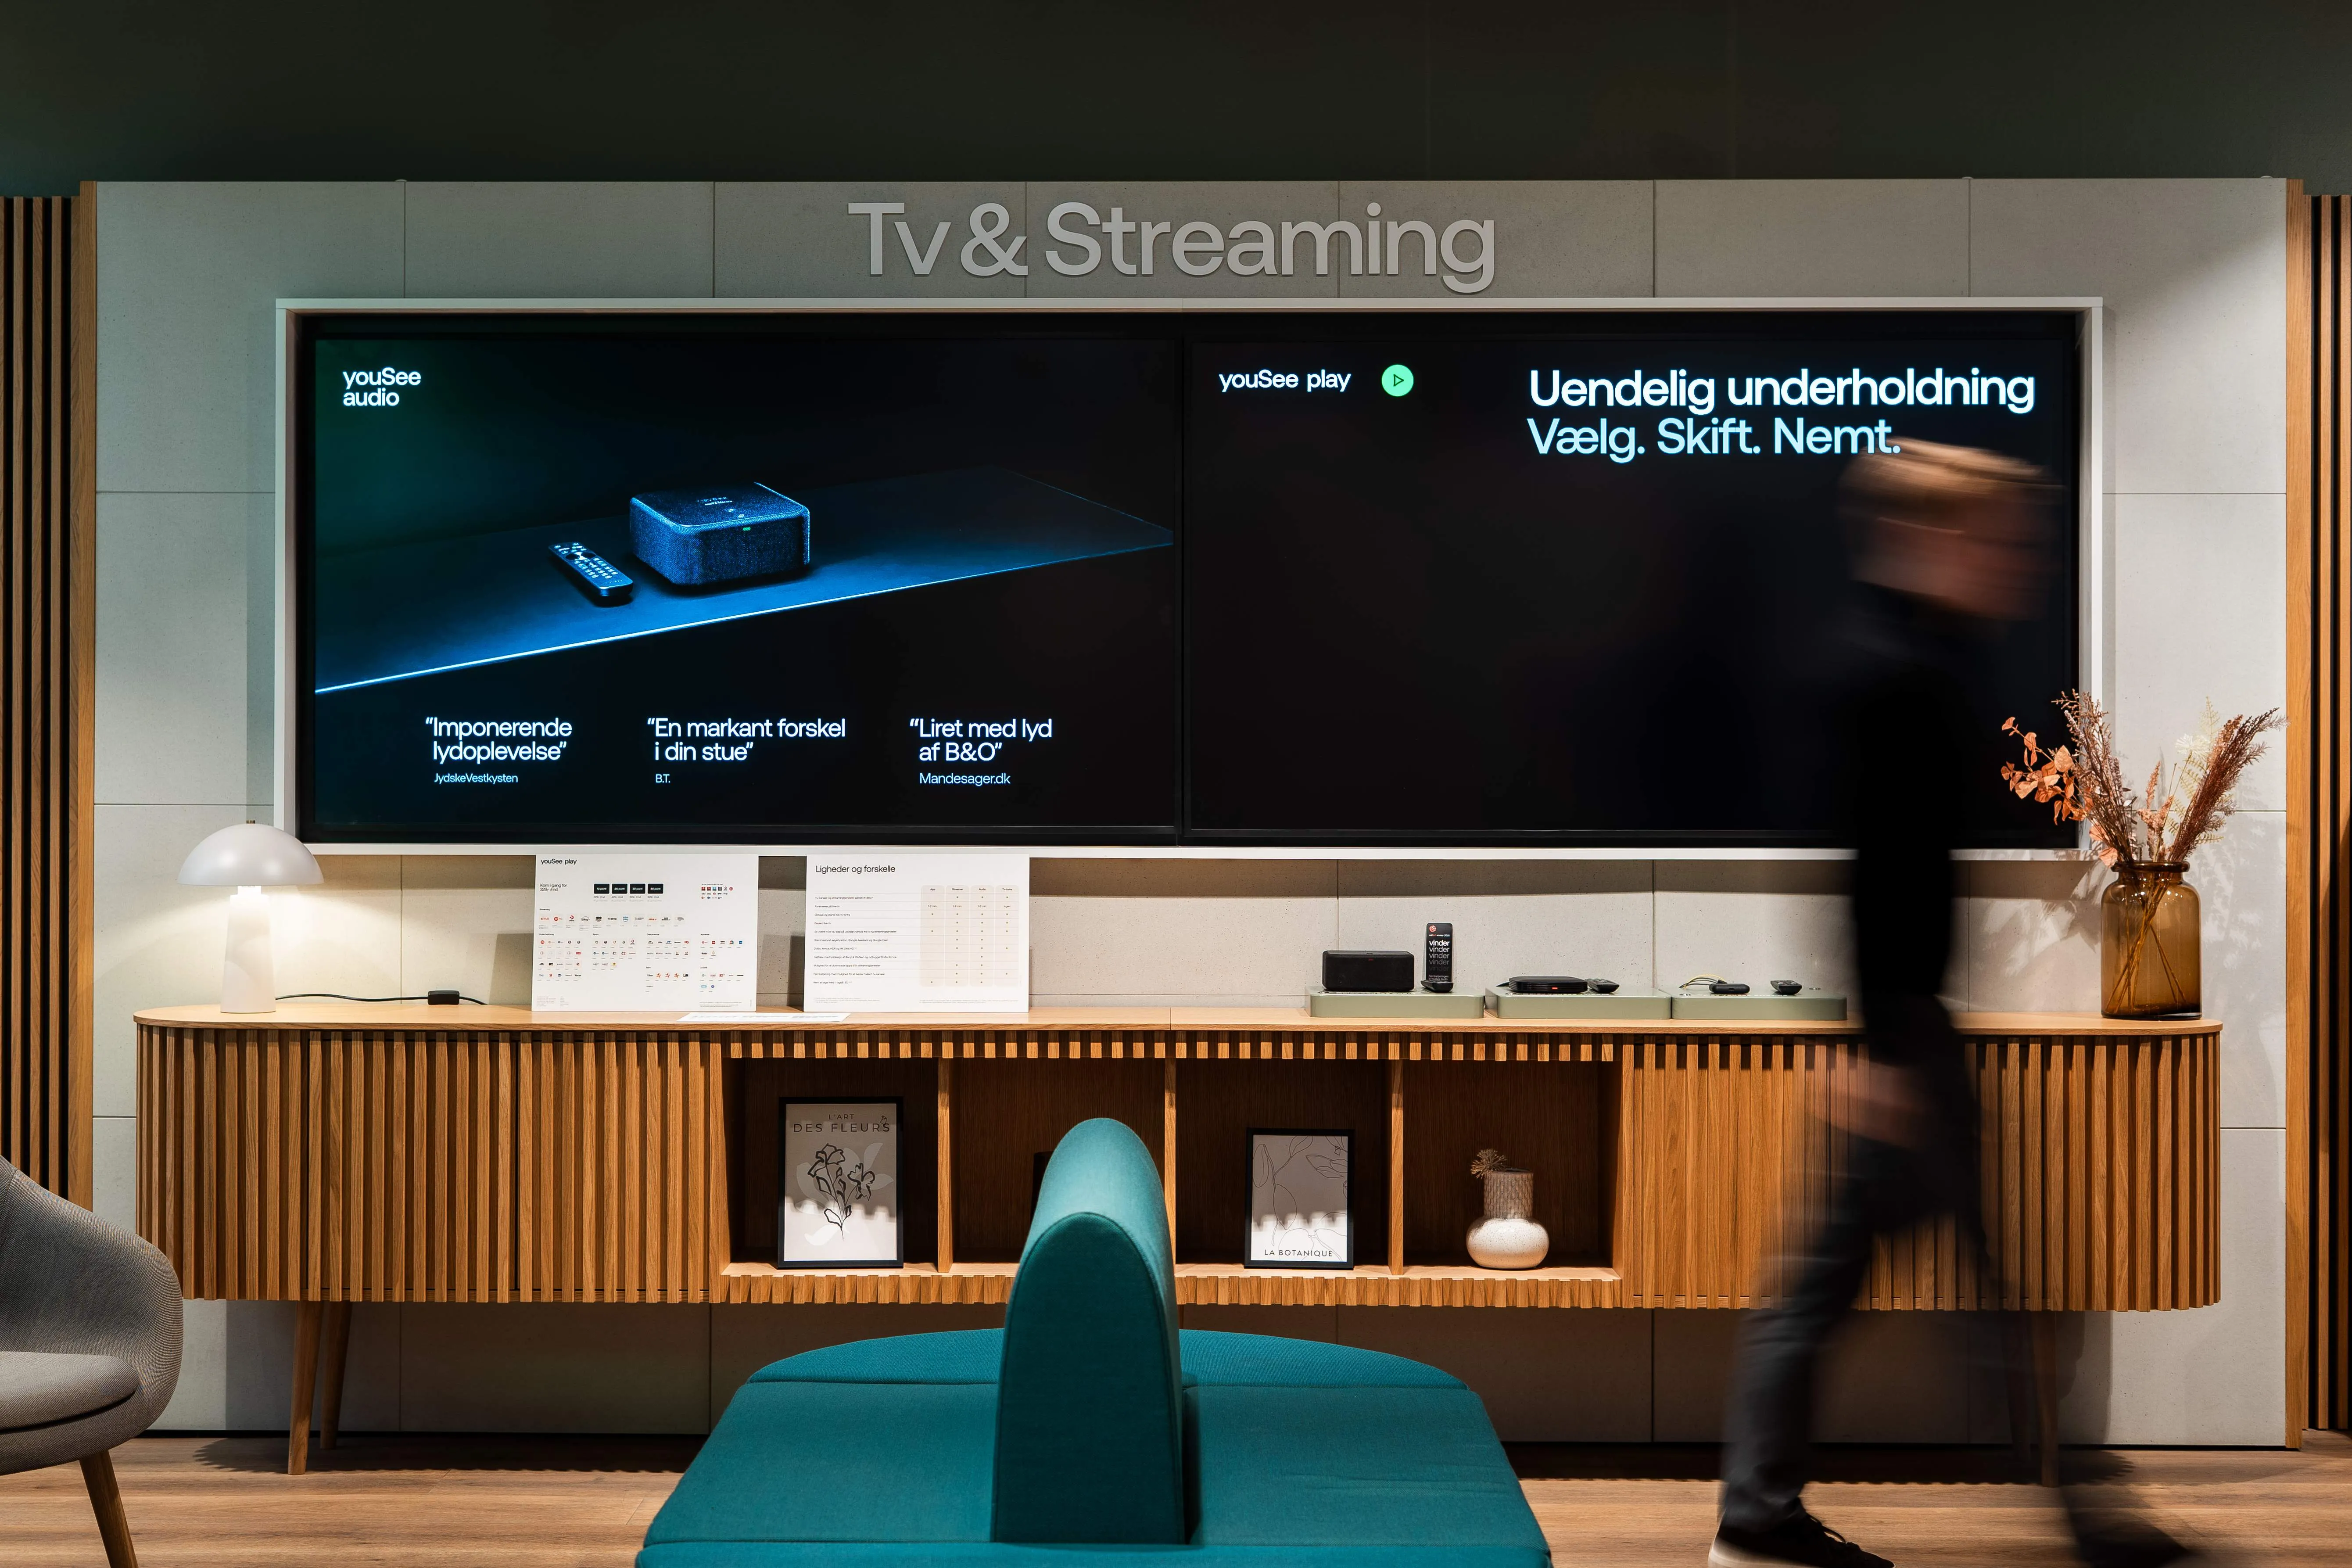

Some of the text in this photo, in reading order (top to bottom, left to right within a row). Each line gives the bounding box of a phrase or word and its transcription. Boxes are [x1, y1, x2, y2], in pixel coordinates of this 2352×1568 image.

[848, 202, 1495, 294] Tv & Streaming
[343, 367, 421, 389] youSee
[1219, 369, 1352, 392] youSee play
[343, 388, 400, 406] audio
[1531, 367, 2034, 415] Uendelig underholdning
[1526, 417, 1900, 463] Vælg. Skift. Nemt.
[687, 718, 773, 737] markant
[777, 718, 845, 737] forskel
[968, 718, 1016, 738] med
[1022, 718, 1052, 742] lyd
[655, 741, 659, 761] i
[665, 742, 696, 761] din
[919, 742, 940, 761] af
[434, 773, 518, 785] JydskeVestkysten
[656, 774, 670, 783] B.T.
[920, 772, 1011, 786] Mandesager.dk
[816, 865, 850, 874] Ligheder
[793, 1123, 890, 1133] DES FLEURS
